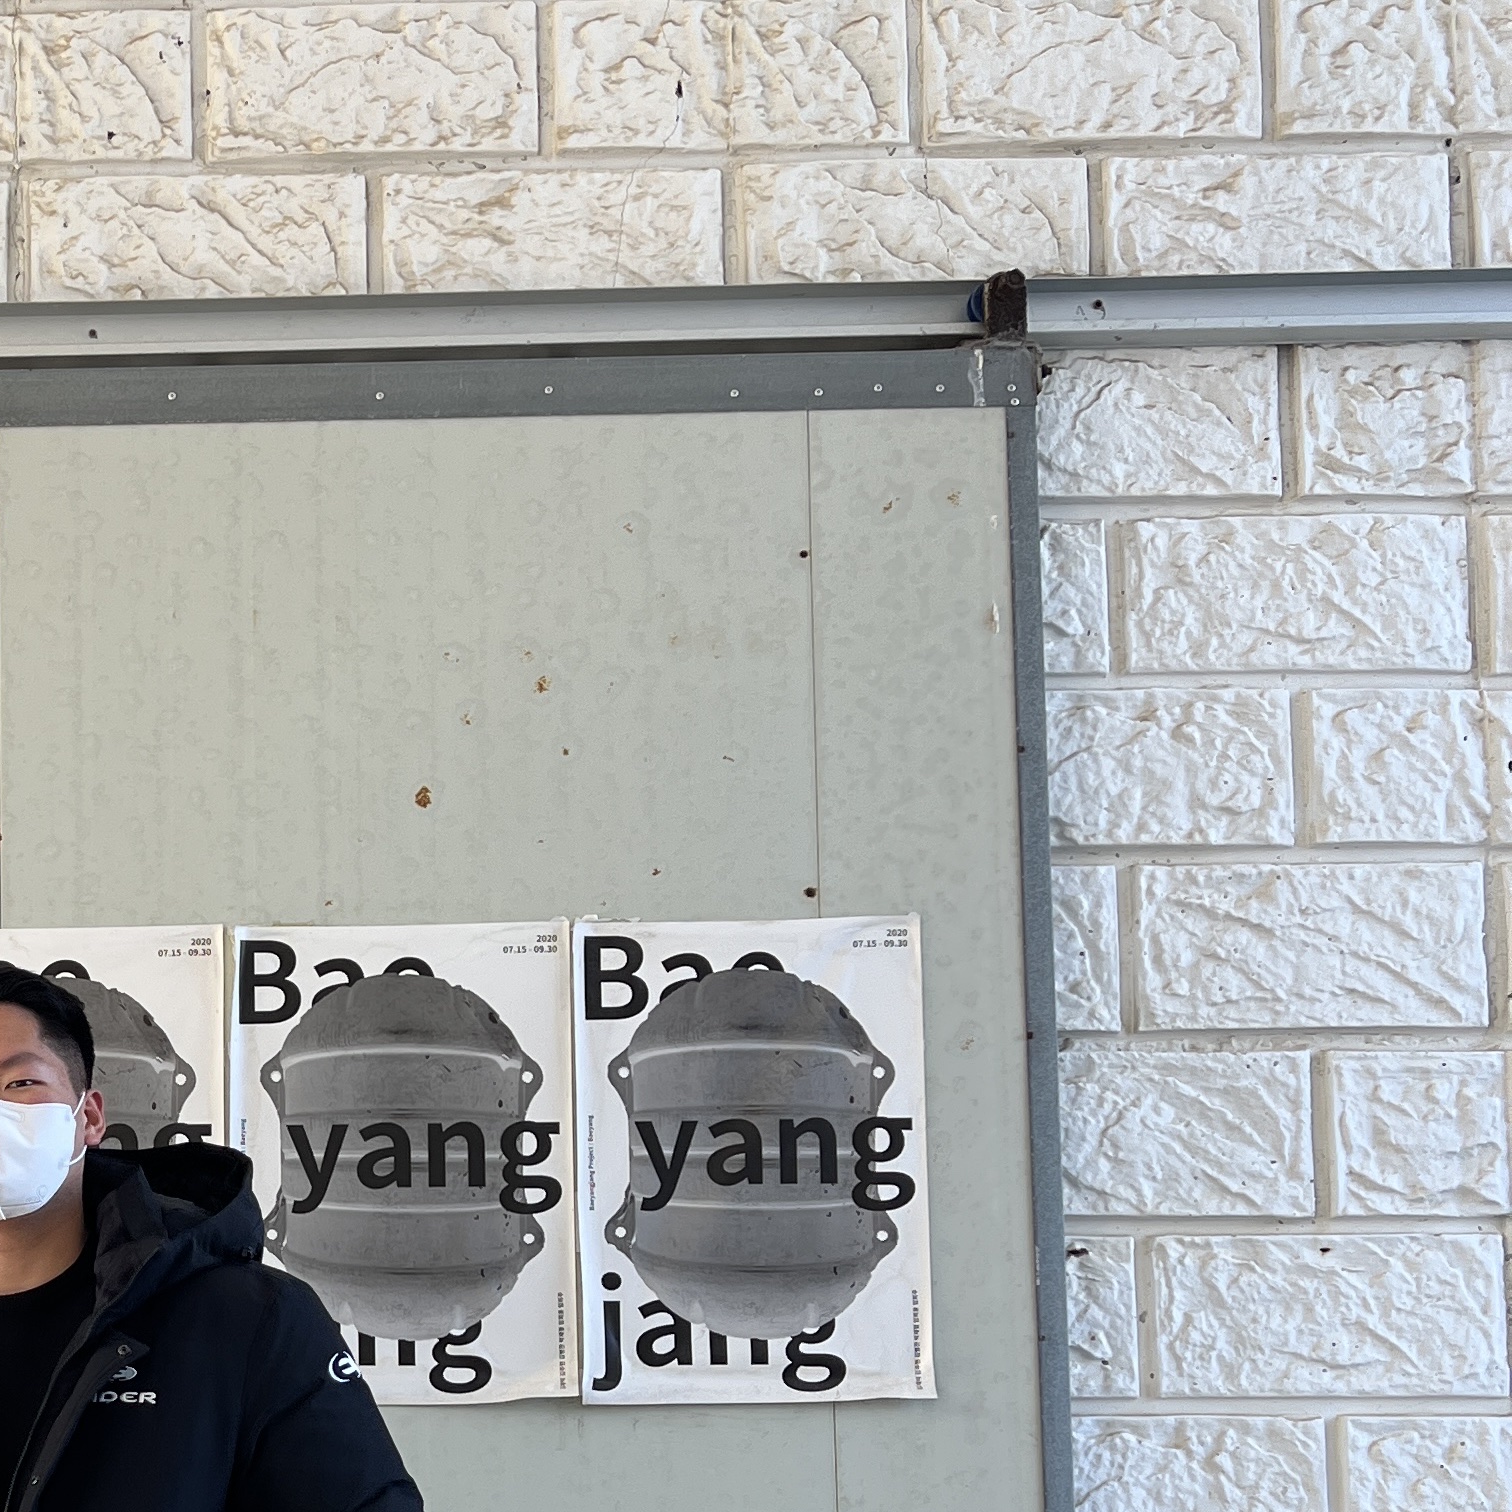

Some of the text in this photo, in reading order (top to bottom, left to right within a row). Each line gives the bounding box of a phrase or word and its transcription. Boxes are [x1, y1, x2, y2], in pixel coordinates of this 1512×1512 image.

[191, 938, 212, 946] 2020
[537, 935, 558, 943] 2020
[887, 929, 908, 937] 2020
[239, 940, 435, 1024] Ba
[583, 935, 785, 1020] Ba
[286, 1120, 563, 1215] yang
[635, 1116, 916, 1212] yang
[92, 1390, 157, 1405] IDER
